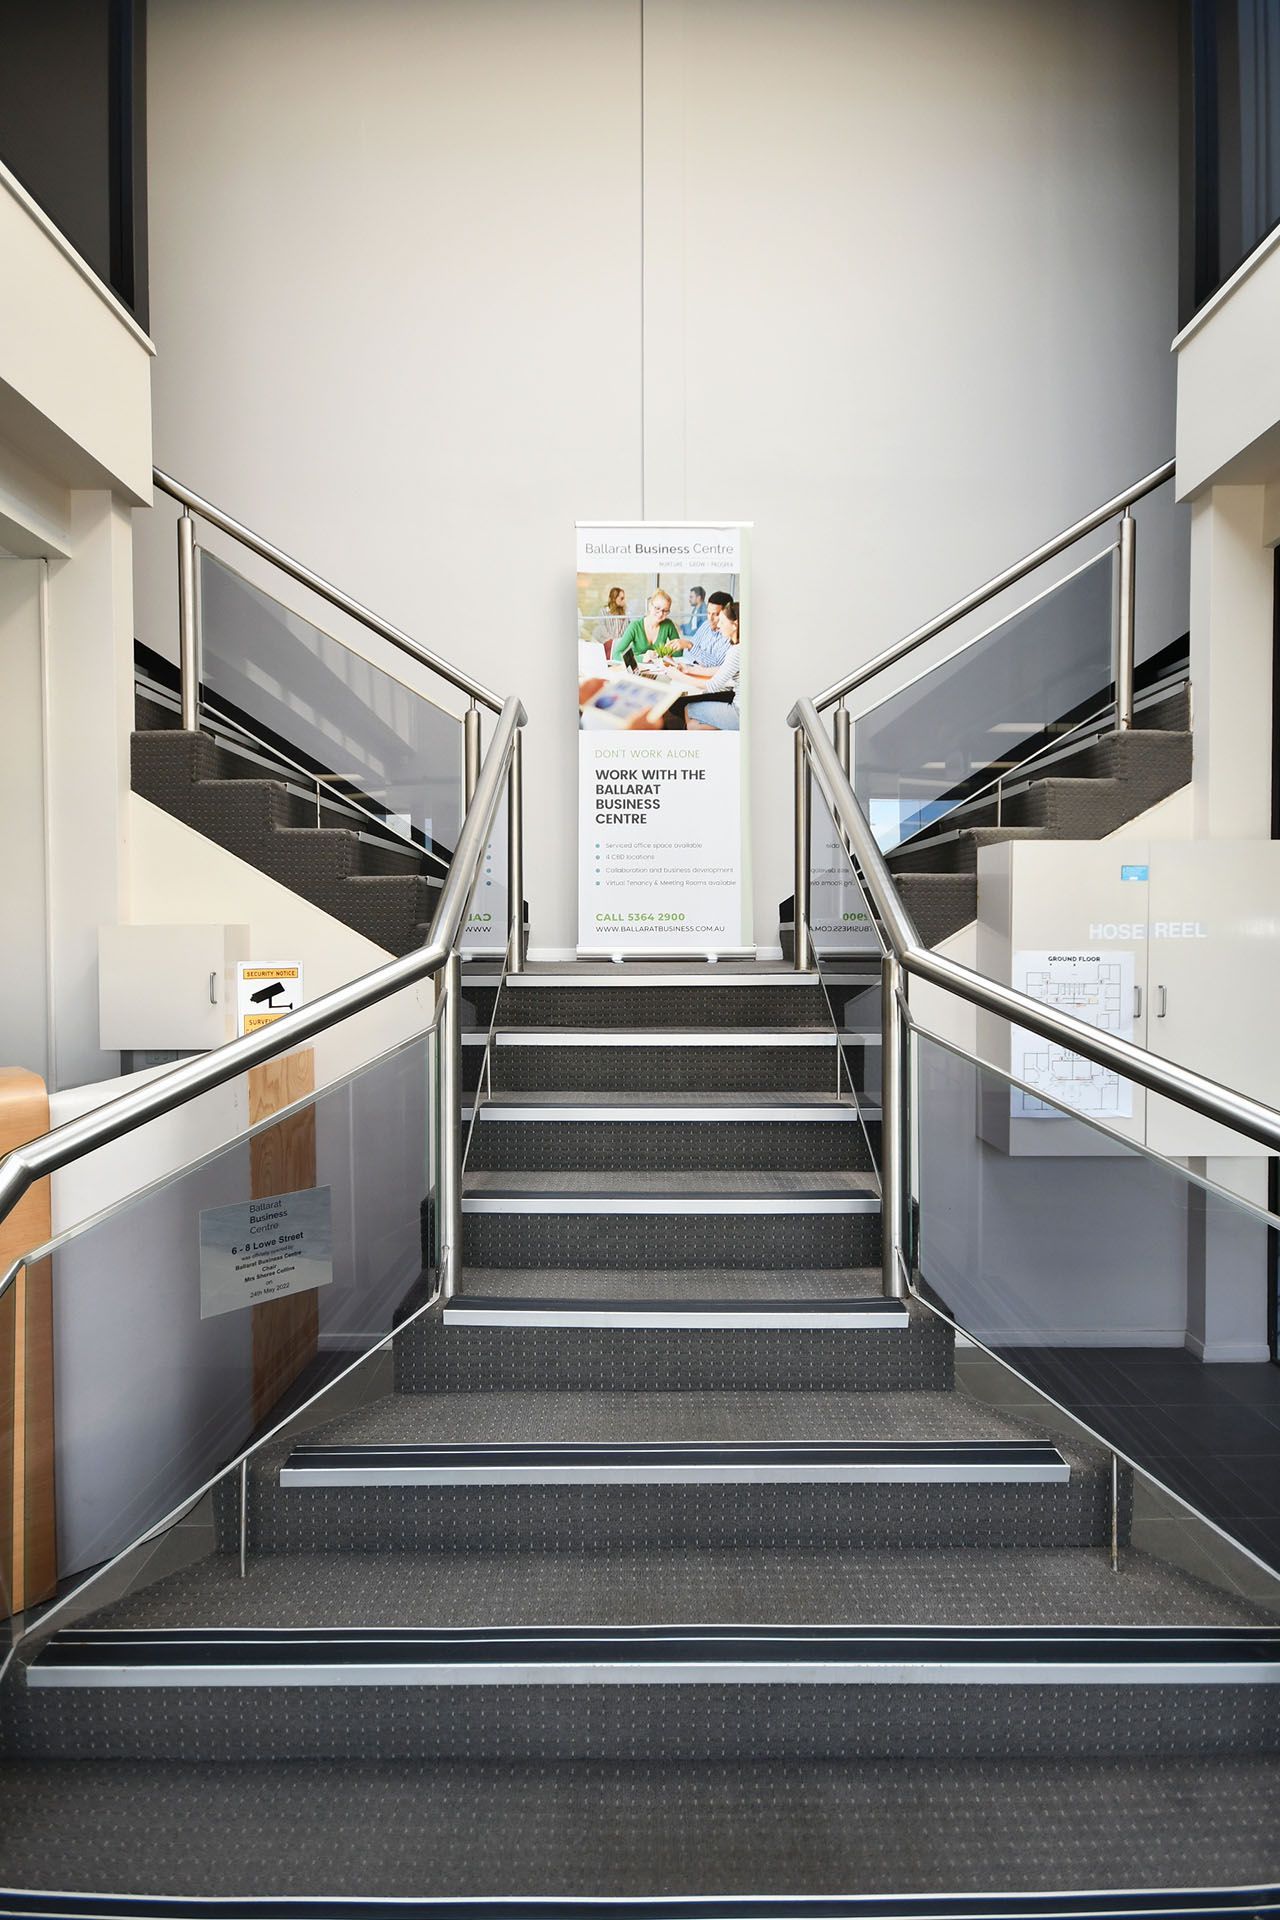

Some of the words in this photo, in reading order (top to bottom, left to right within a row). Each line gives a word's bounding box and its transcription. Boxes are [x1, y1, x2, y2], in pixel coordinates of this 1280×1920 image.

[585, 543, 632, 554] Ballarat
[635, 543, 690, 554] Business
[693, 543, 734, 554] Centre
[594, 749, 626, 759] DON'T
[630, 749, 662, 759] WORK
[666, 749, 701, 759] ALONE
[595, 769, 638, 780] WORK
[641, 769, 677, 780] WITH
[681, 769, 706, 780] THE
[595, 784, 661, 795] BALLARAT
[595, 799, 661, 810] BUSINESS
[595, 813, 648, 824] CENTRE
[652, 843, 673, 851] space
[605, 866, 649, 874] Collaboration
[649, 866, 662, 874] and
[663, 866, 691, 874] business
[691, 866, 734, 876] development
[605, 879, 626, 887] Virtual
[626, 879, 653, 889] Tenancy
[659, 879, 685, 889] Meeting
[708, 879, 736, 887] available
[595, 913, 625, 921] CALL
[628, 913, 655, 921] 5364
[658, 913, 686, 921] 2900
[1088, 923, 1146, 940] HOSE
[1154, 922, 1208, 938] REEL
[249, 1200, 282, 1213] Ballarat
[249, 1210, 288, 1224] Business
[250, 1223, 279, 1234] Centre
[231, 1247, 238, 1255] 6
[245, 1243, 251, 1252] 8
[253, 1239, 277, 1250] Lowe
[278, 1231, 304, 1244] Street
[257, 1255, 283, 1266] Business
[284, 1250, 302, 1259] Centre
[261, 1264, 277, 1272] Chair
[263, 1287, 275, 1295] May
